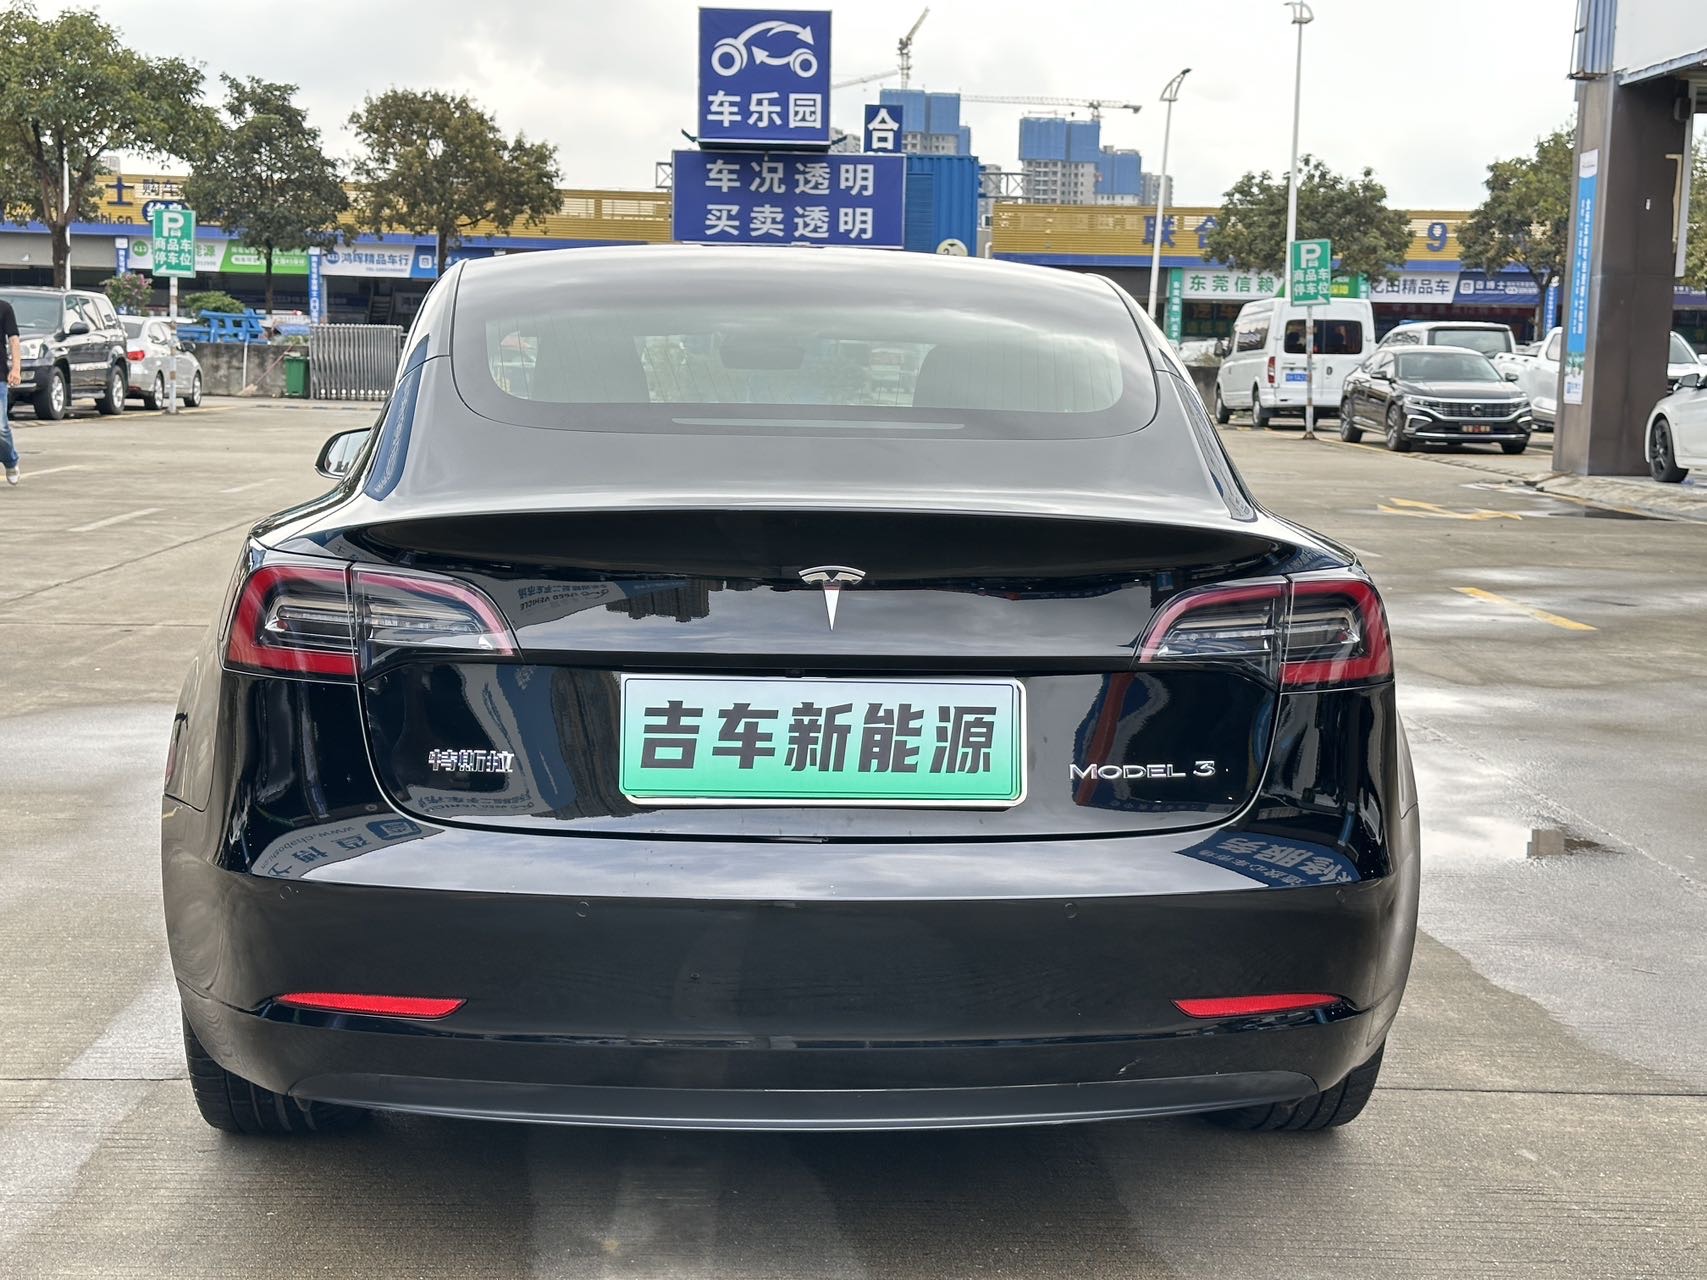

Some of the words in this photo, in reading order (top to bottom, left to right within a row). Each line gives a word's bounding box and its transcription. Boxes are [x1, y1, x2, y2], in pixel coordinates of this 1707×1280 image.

[706, 90, 822, 128] 车乐园
[867, 108, 899, 150] 合
[704, 160, 875, 196] 车况透明
[162, 212, 185, 237] P
[704, 204, 874, 239] 买卖透明
[155, 238, 192, 252] 商品车
[1300, 244, 1322, 268] P
[155, 252, 192, 266] 停车位
[1189, 275, 1274, 292] 东莞信赖
[1294, 268, 1330, 281] 商品车
[1294, 282, 1330, 296] 停车位
[640, 700, 997, 774] 吉车新能源
[428, 749, 514, 772] 特斯拉
[1069, 763, 1186, 780] MODEL
[1193, 760, 1216, 777] 3
